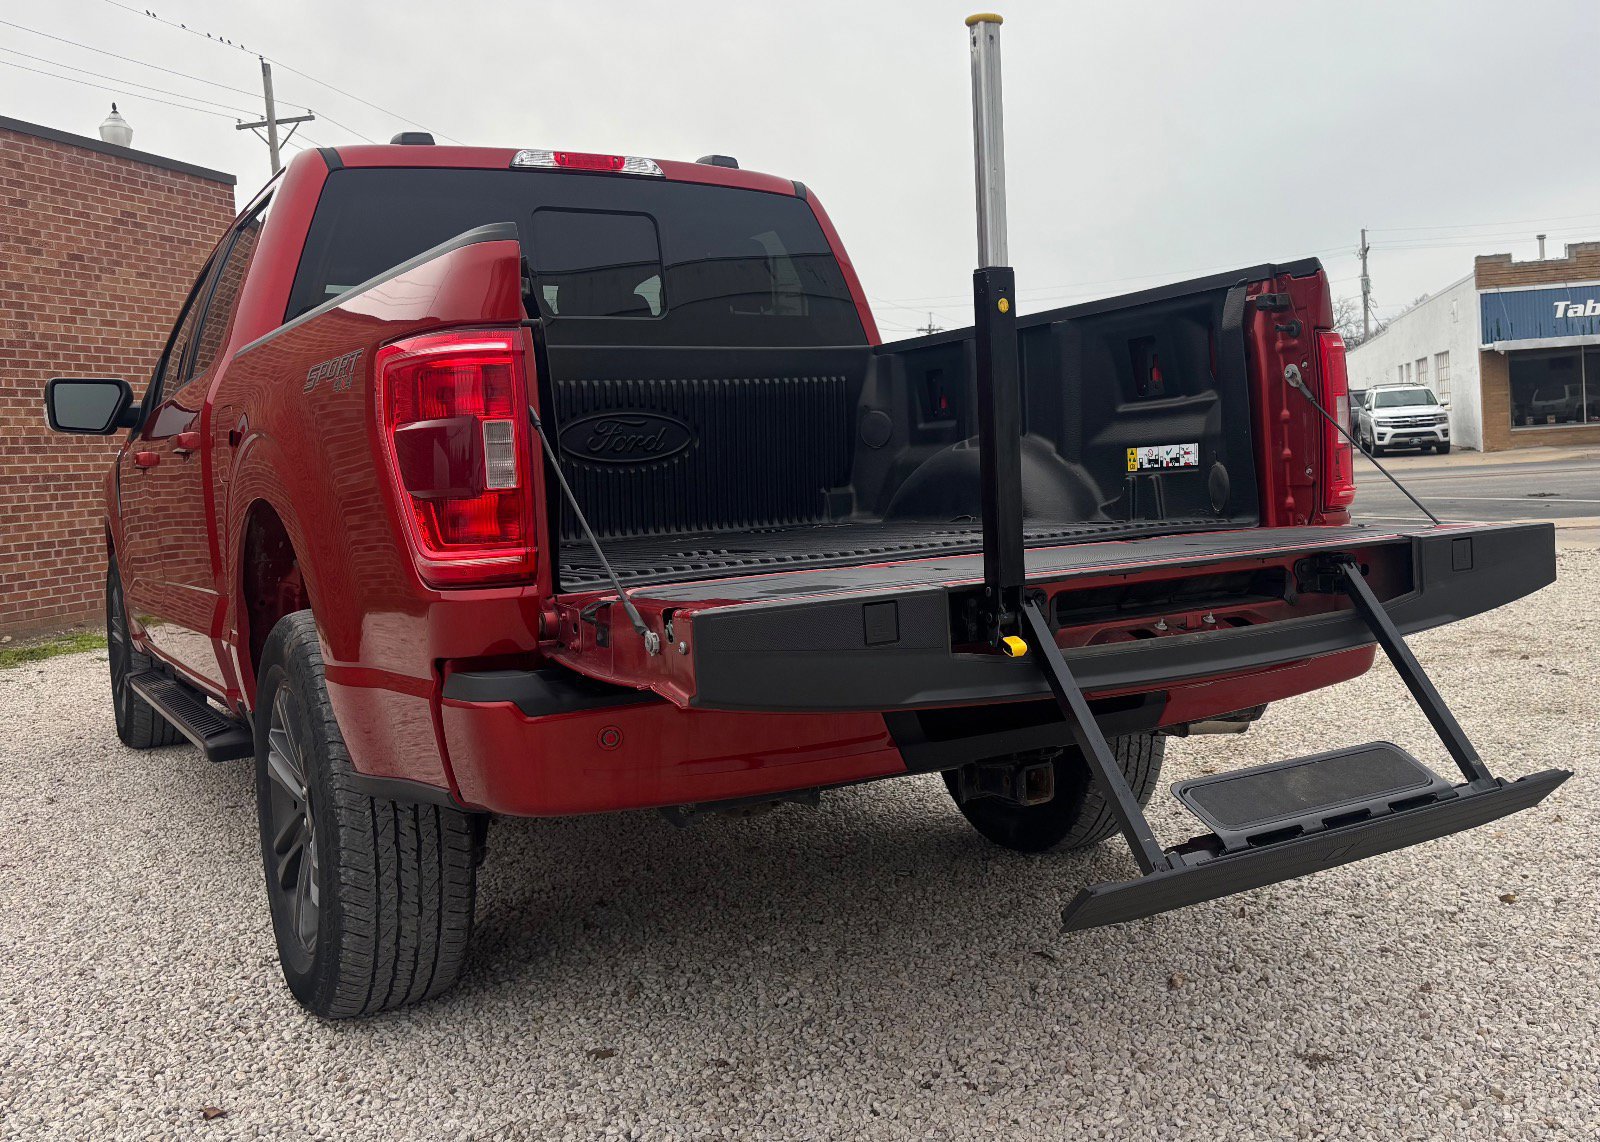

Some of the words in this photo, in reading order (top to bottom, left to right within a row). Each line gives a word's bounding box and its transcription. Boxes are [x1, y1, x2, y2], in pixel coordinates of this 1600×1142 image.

[1553, 299, 1600, 319] Tab
[302, 347, 365, 394] SPORT
[587, 419, 668, 452] Ford
